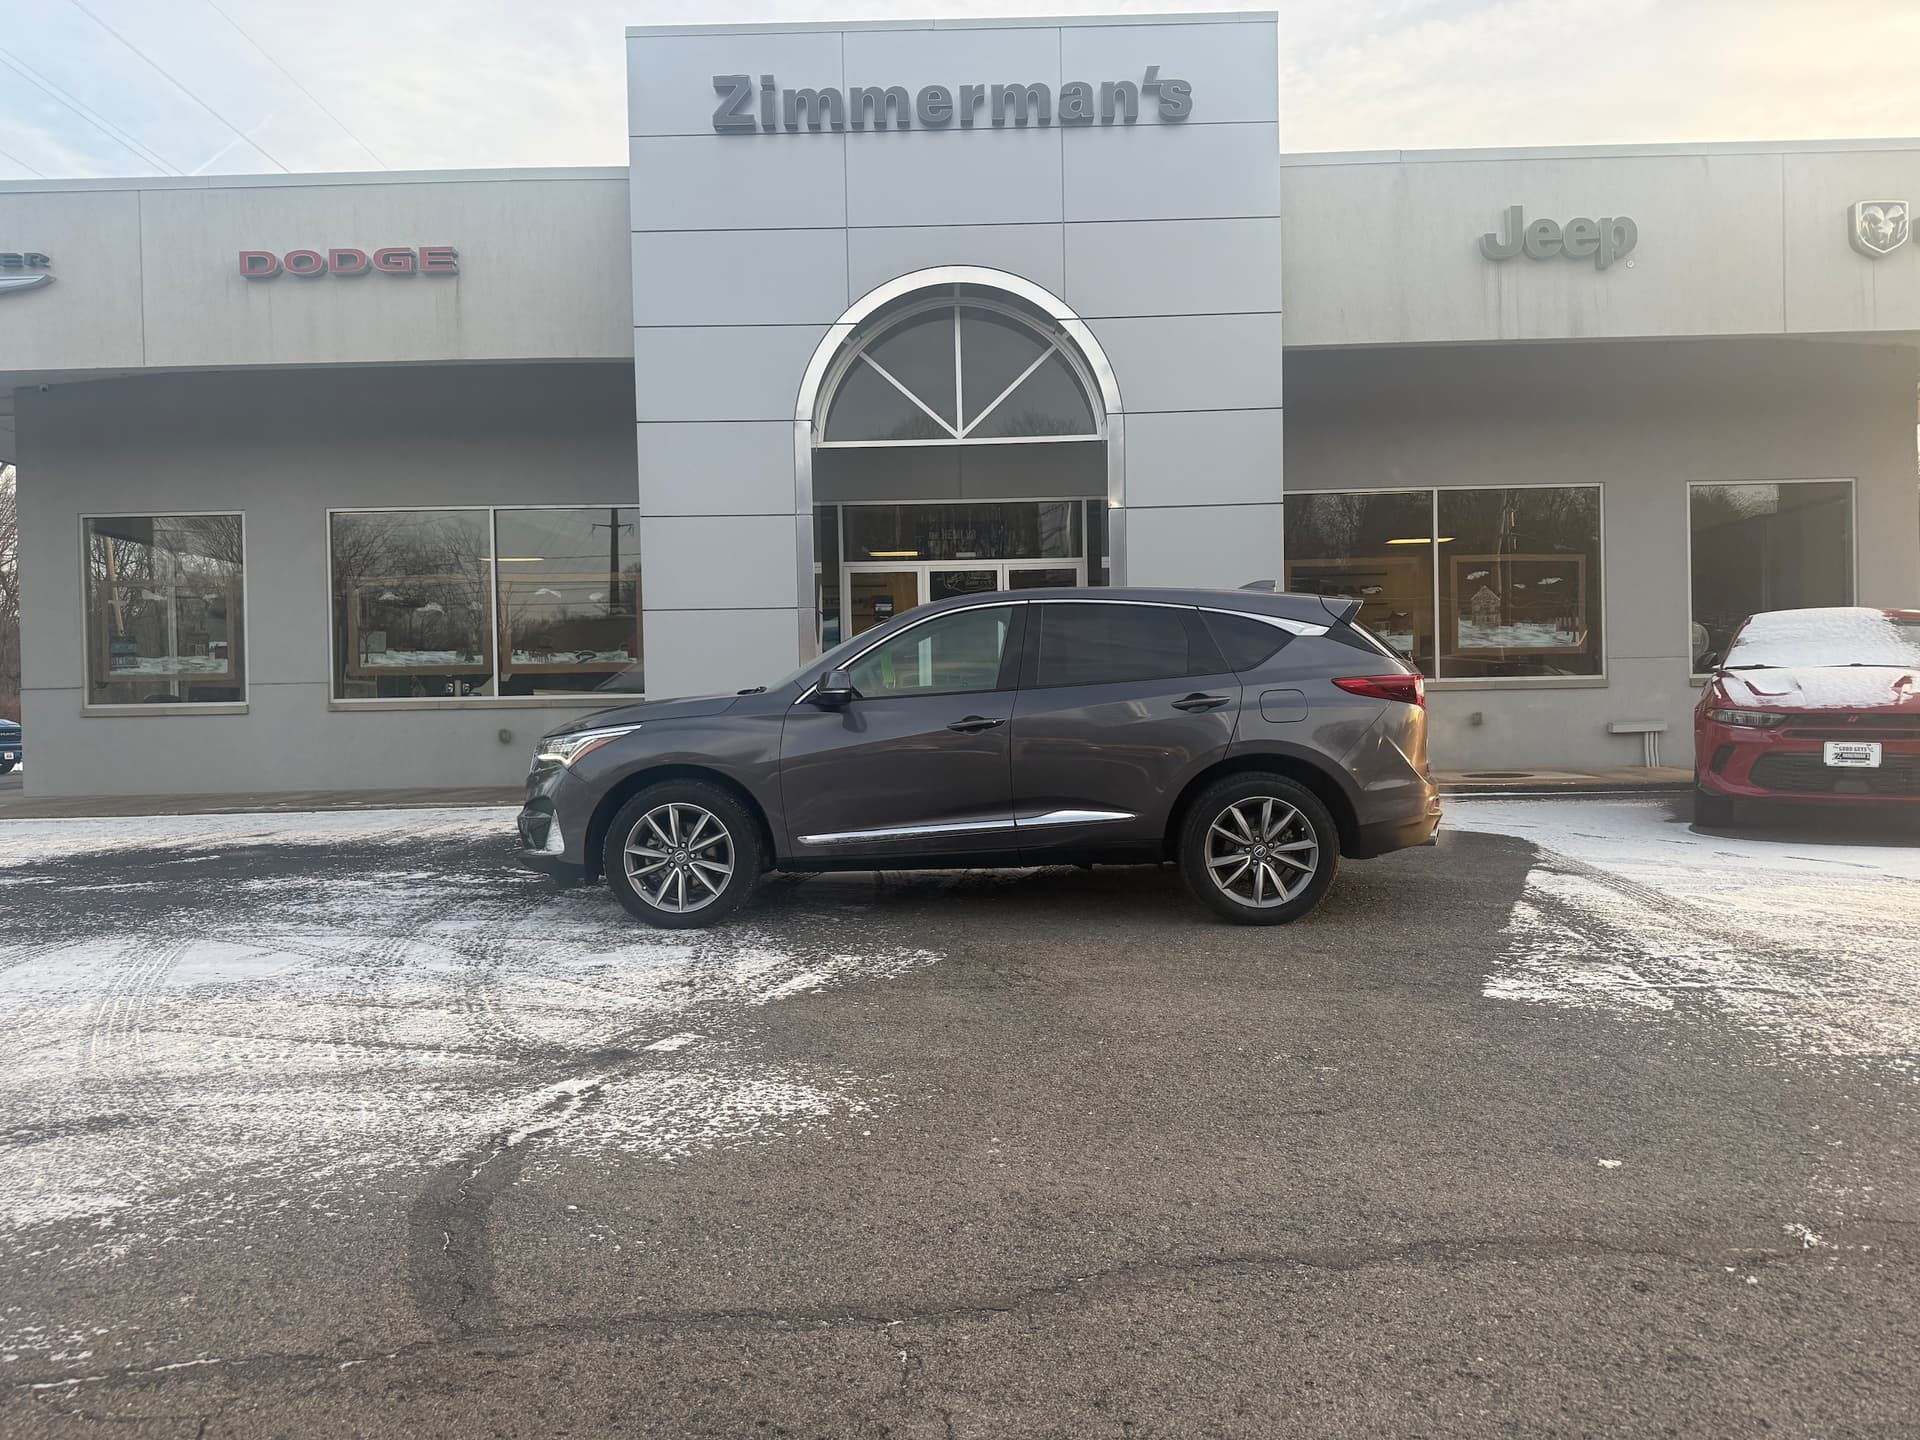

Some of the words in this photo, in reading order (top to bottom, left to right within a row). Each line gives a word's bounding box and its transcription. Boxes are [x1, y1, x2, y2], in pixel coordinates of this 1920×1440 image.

[712, 65, 1193, 132] Zimmerman's
[238, 246, 459, 278] DODGE
[1479, 204, 1639, 271] Jeep
